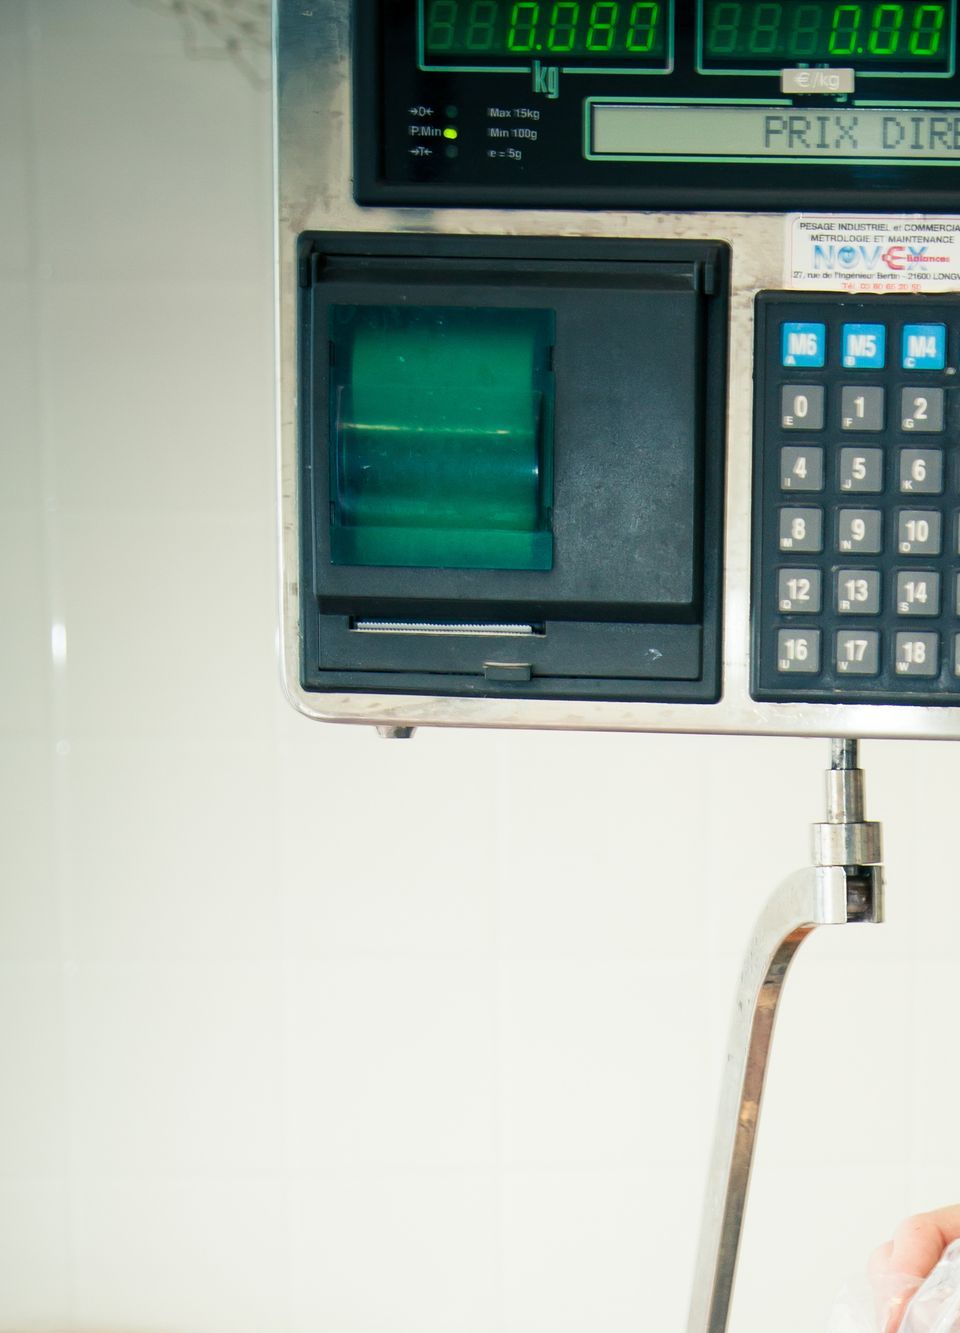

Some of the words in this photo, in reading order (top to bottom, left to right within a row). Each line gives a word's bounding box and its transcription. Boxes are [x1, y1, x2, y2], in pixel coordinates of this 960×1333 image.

[507, 2, 658, 52] 0.080
[828, 5, 945, 55] 0.00
[532, 60, 559, 99] kg
[795, 72, 840, 90] €/kg
[488, 107, 511, 118] Max
[514, 108, 540, 120] 15kg
[409, 125, 441, 137] P.Min
[488, 128, 509, 138] Min
[513, 128, 537, 140] 100g
[763, 116, 858, 149] PRIX
[507, 148, 522, 160] 5g
[800, 222, 835, 231] PESAGE
[838, 223, 890, 232] INDUSTRIEL
[888, 235, 955, 244] MAINTENANCE
[813, 244, 929, 271] NOVEX
[906, 254, 950, 263] Balances
[788, 333, 818, 356] M6
[847, 334, 877, 357] M5
[908, 335, 937, 358] M4
[785, 355, 796, 365] A
[844, 356, 856, 366] B
[904, 358, 916, 368] C
[794, 395, 808, 418] 0
[854, 396, 865, 418] 1
[913, 398, 928, 420] 2
[784, 416, 794, 426] E
[844, 417, 853, 427] F
[903, 419, 915, 428] G
[793, 456, 808, 479] 4
[852, 457, 866, 480] 5
[912, 459, 926, 482] 6
[902, 480, 913, 490] K
[791, 518, 806, 540] 8
[851, 519, 866, 541] 9
[904, 520, 929, 543] 10
[780, 538, 793, 548] M
[840, 540, 852, 550] N
[786, 578, 811, 601] 12
[844, 579, 869, 602] 13
[904, 581, 928, 604] 14
[841, 600, 851, 610] R
[900, 602, 910, 612] S
[784, 639, 809, 661] 16
[844, 640, 869, 661] 17
[901, 641, 926, 664] 18
[839, 661, 849, 671] V
[896, 662, 910, 672] W
